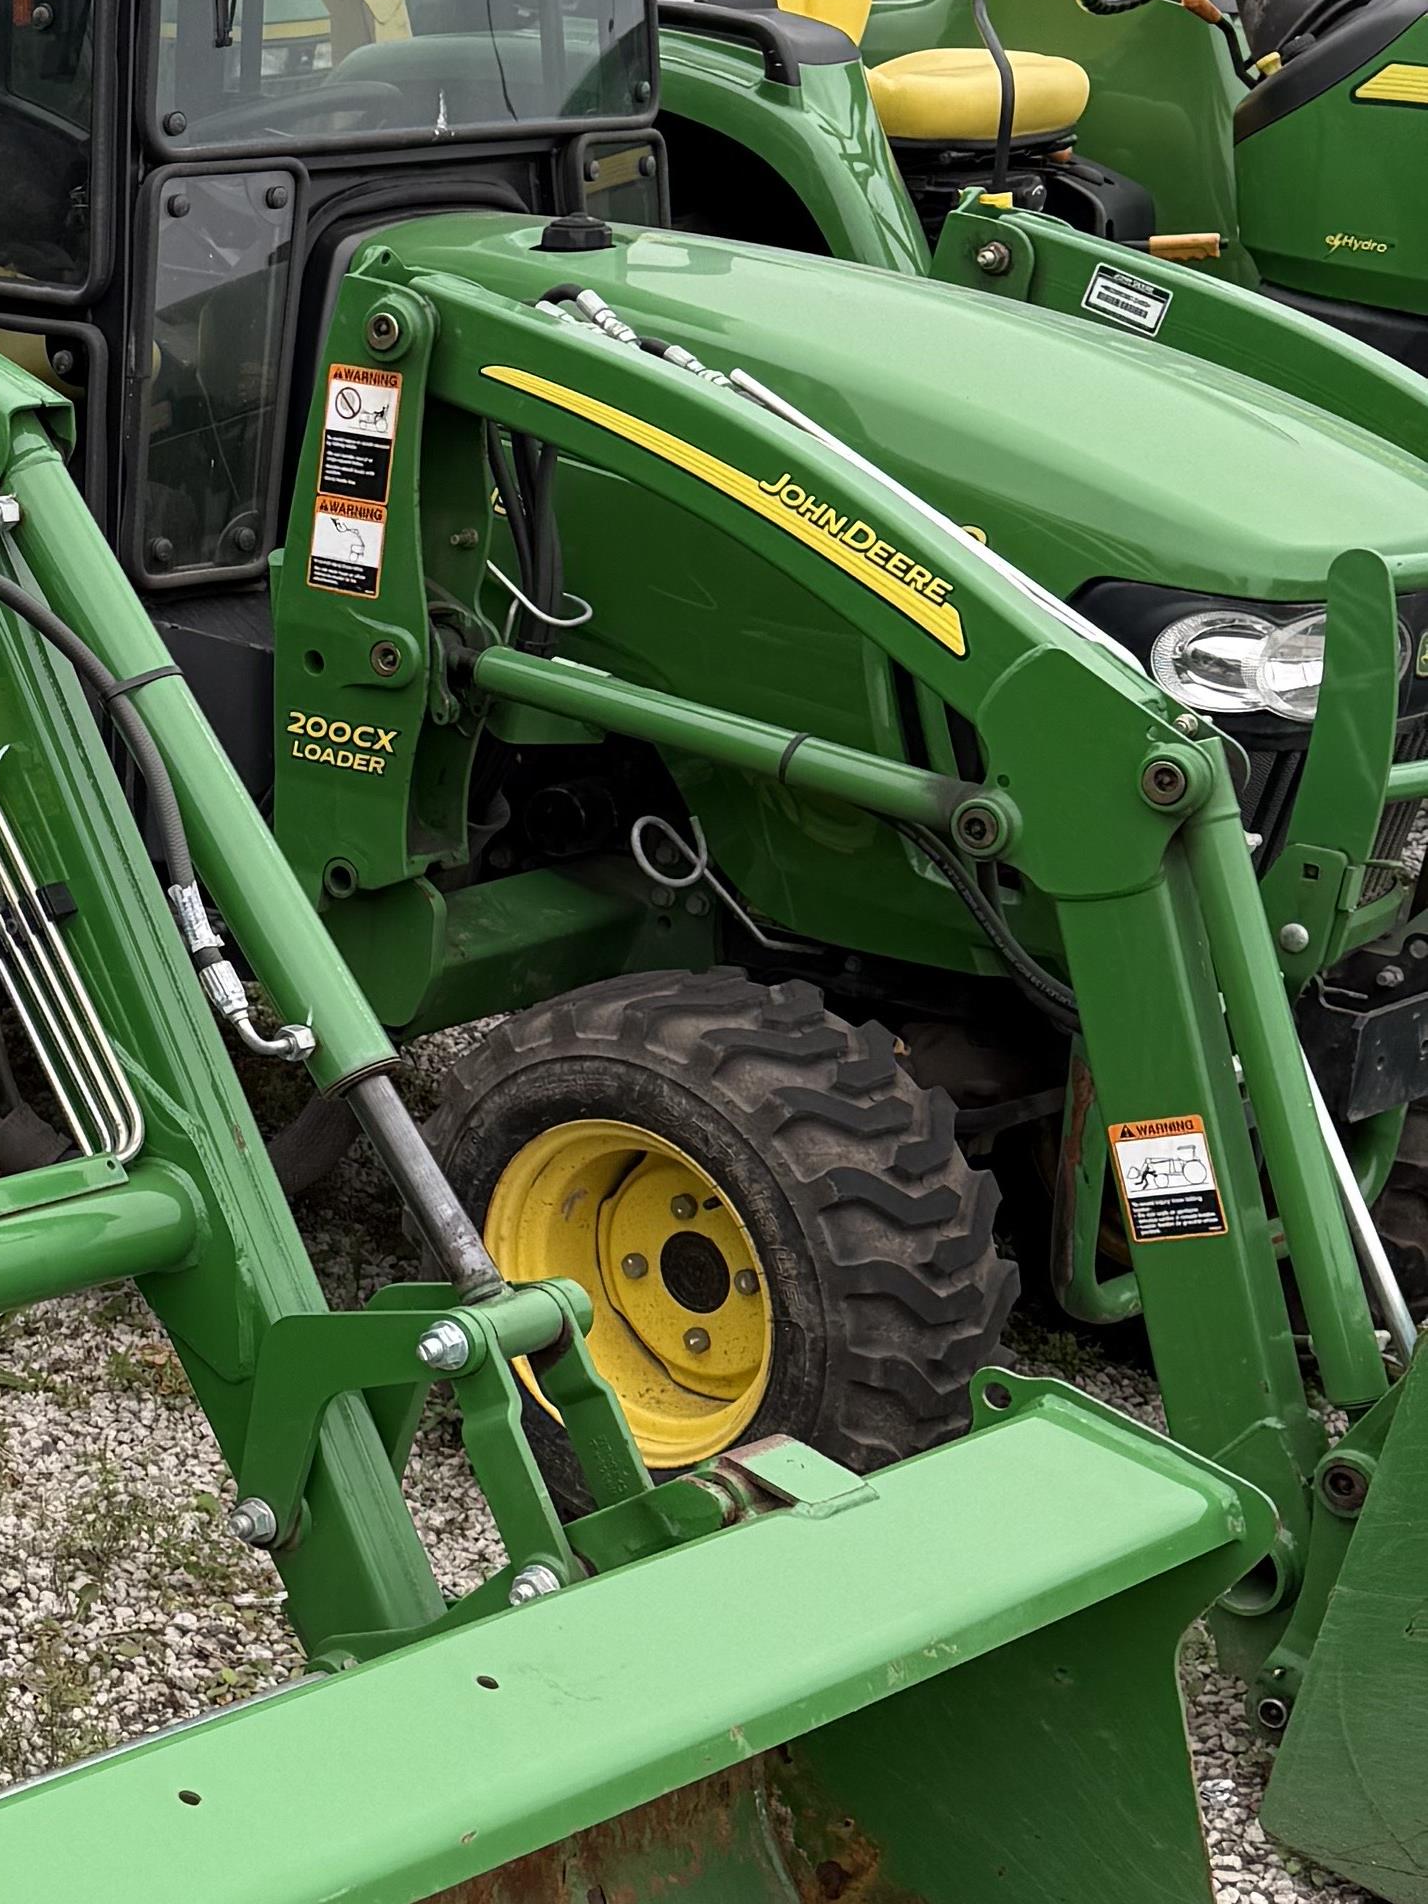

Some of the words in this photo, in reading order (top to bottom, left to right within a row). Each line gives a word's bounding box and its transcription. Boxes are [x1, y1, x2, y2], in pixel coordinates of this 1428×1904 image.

[344, 367, 398, 387] WARNING
[329, 499, 383, 521] WARNING
[759, 472, 848, 538] JOHN
[841, 519, 954, 604] DEERE
[287, 711, 398, 752] 200CX
[292, 740, 386, 774] LOADER
[1135, 1119, 1194, 1137] WARNING
